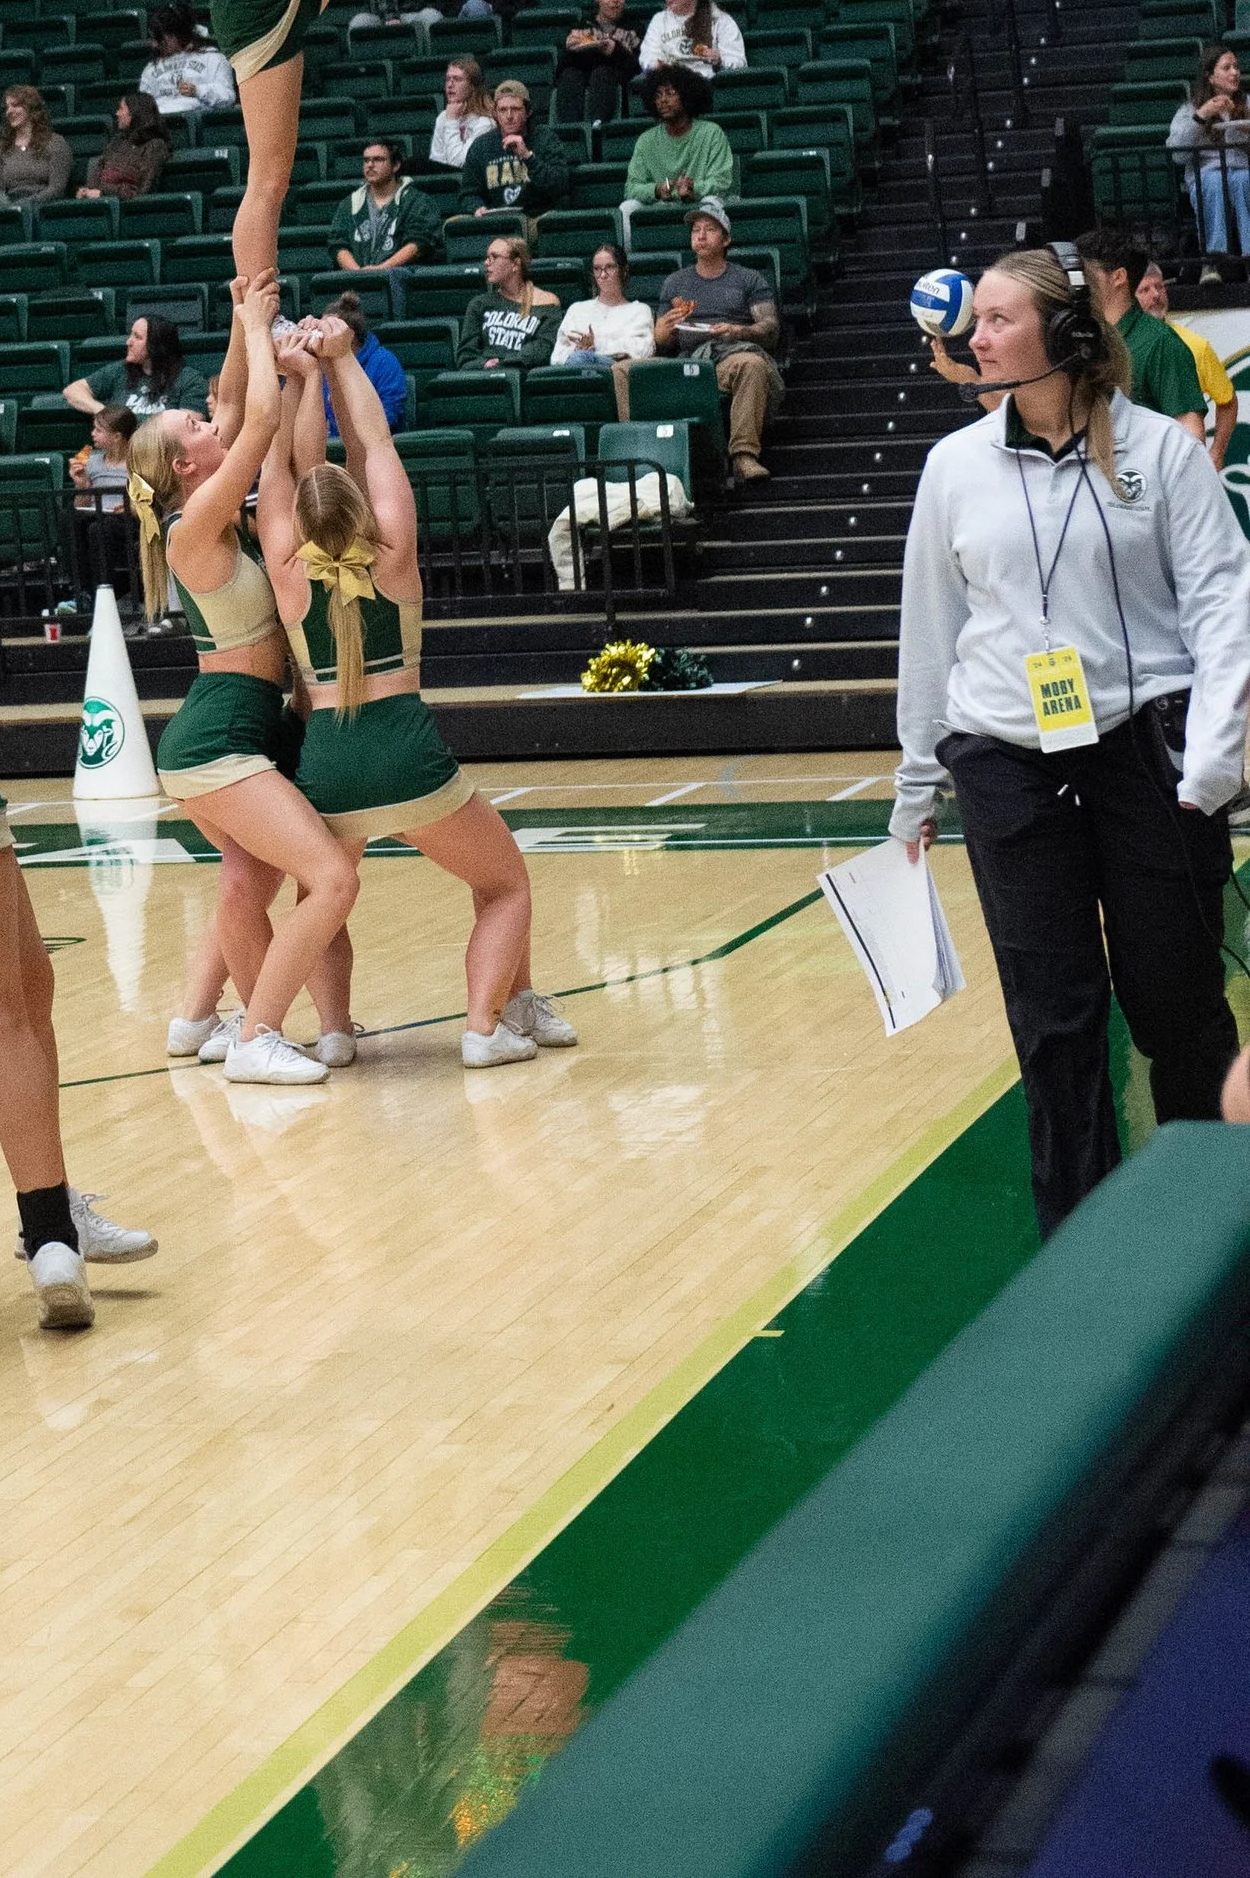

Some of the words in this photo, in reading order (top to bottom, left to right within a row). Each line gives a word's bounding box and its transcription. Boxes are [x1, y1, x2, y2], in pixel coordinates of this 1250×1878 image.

[488, 326, 527, 351] STATE
[1040, 678, 1075, 699] MOBY
[1043, 695, 1082, 716] ARENA
